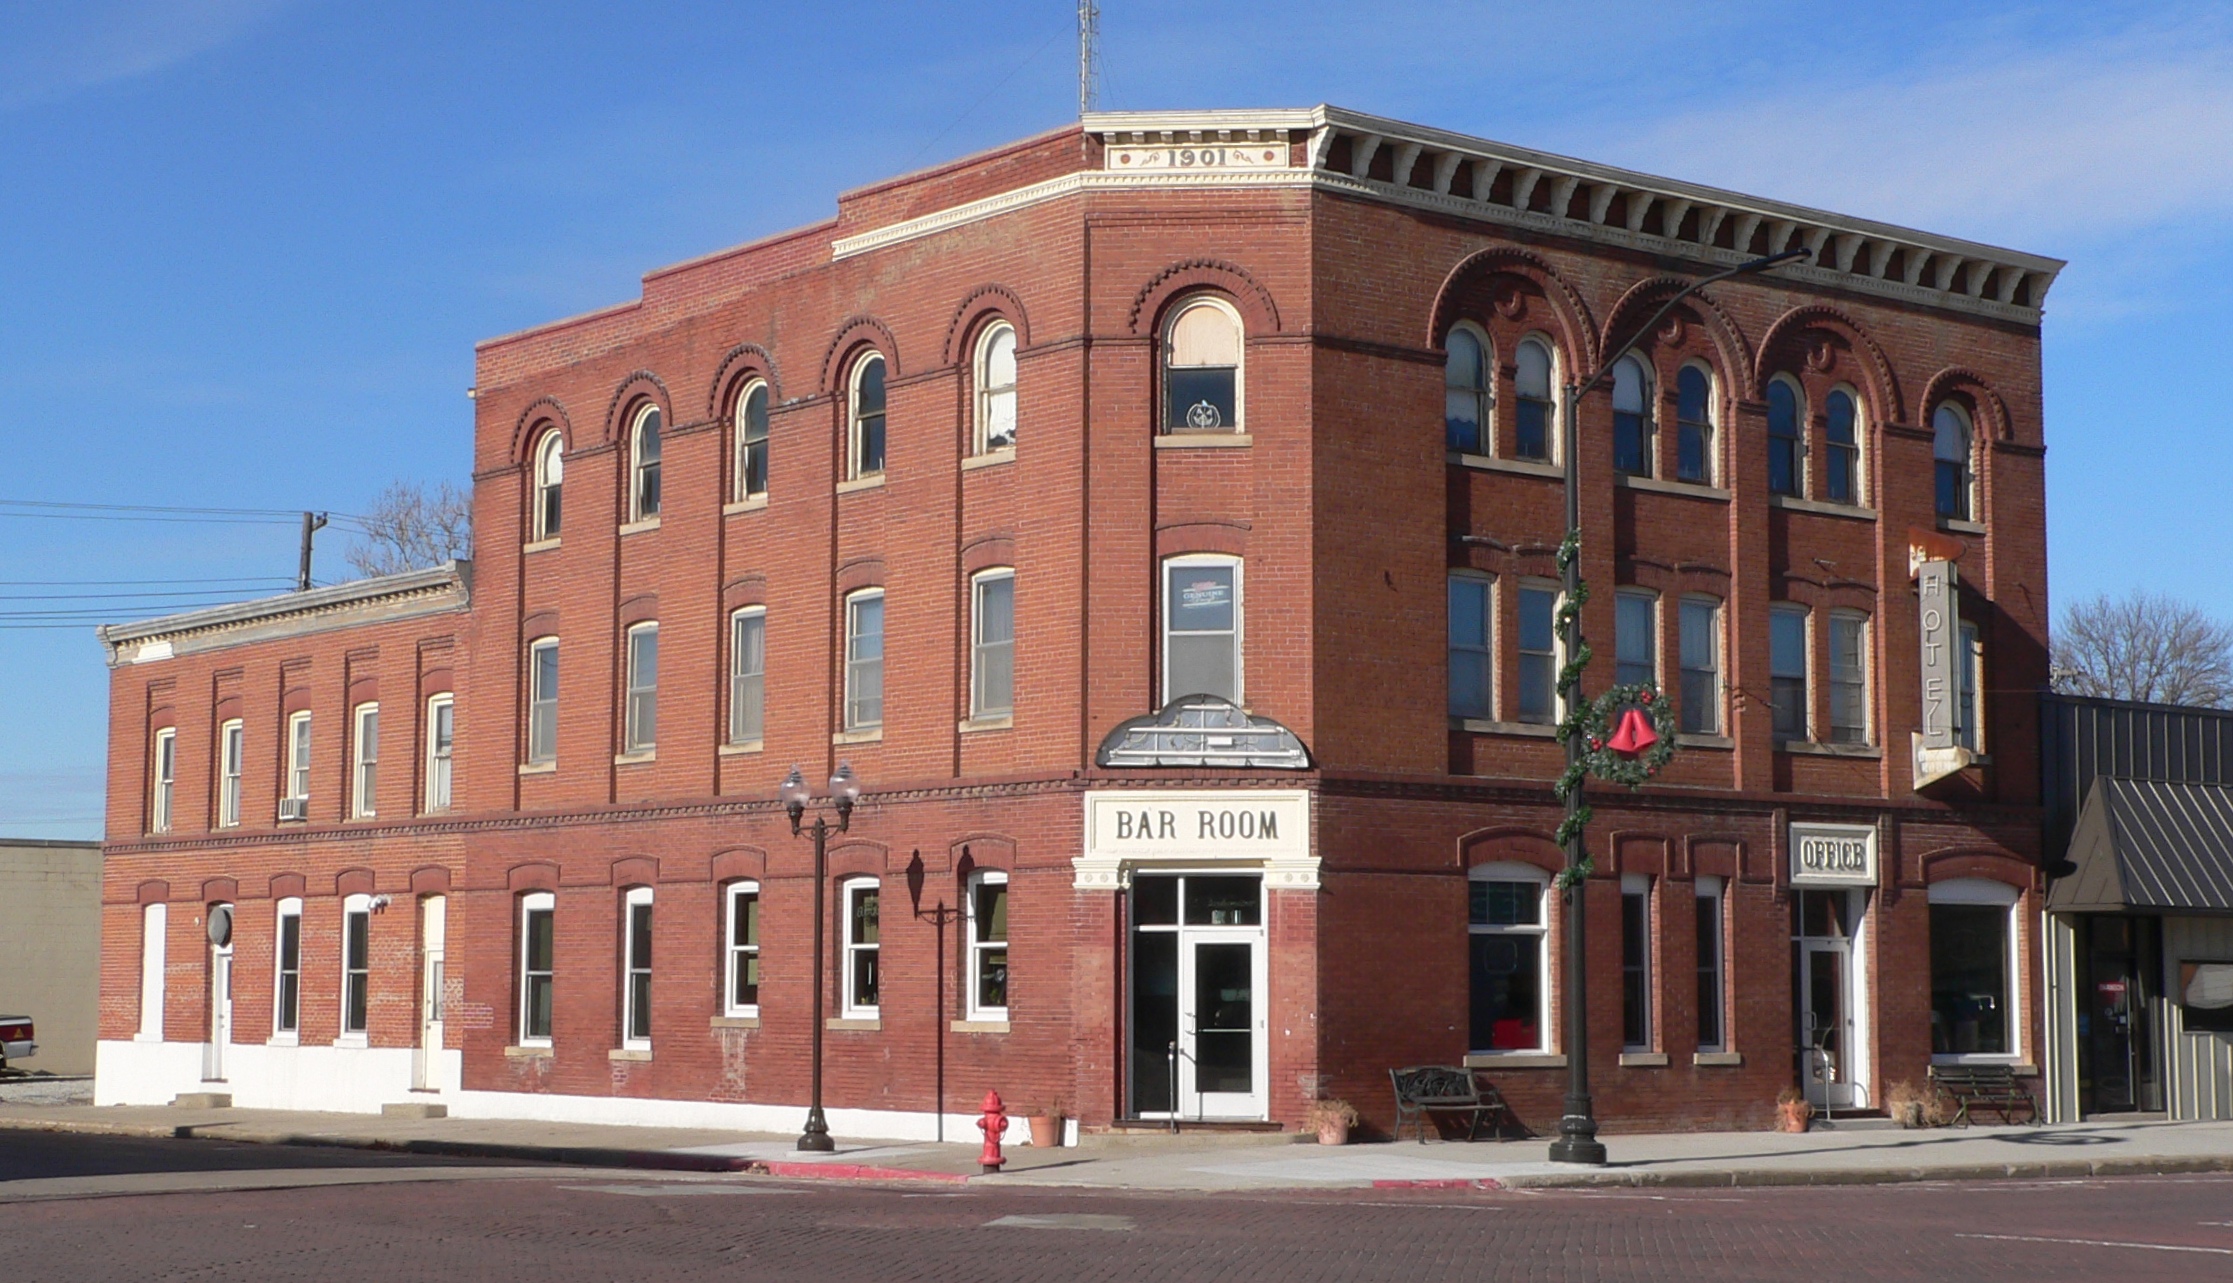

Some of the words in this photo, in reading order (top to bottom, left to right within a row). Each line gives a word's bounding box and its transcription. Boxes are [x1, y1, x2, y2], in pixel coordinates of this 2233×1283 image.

[1168, 149, 1226, 167] 1901
[1183, 590, 1224, 600] GENUINE
[1922, 575, 1943, 736] HOTEL
[1116, 810, 1176, 840] BAR
[1197, 810, 1279, 840] ROOM
[1803, 841, 1865, 870] OFFICE
